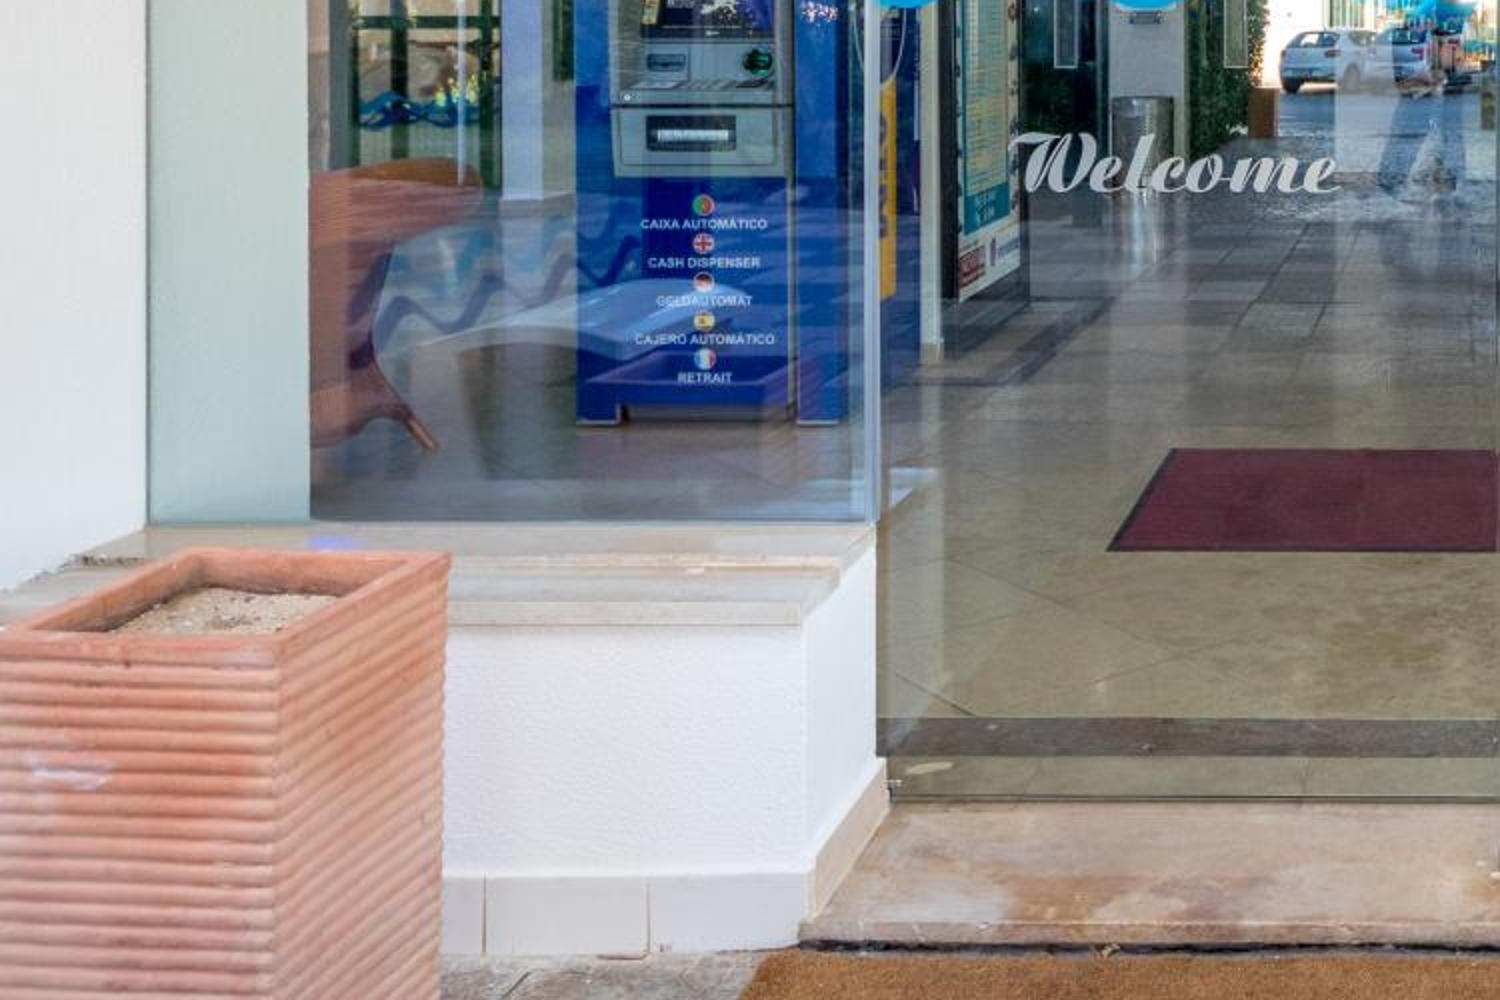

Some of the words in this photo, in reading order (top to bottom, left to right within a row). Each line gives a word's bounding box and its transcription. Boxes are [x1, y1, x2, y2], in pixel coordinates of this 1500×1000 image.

[1008, 131, 1342, 194] Welcome
[640, 218, 680, 230] CAIXA
[648, 257, 685, 269] CASH
[687, 257, 761, 269] DISPENSER
[656, 295, 753, 308] GELDAUTOMAT
[635, 333, 687, 345] CAJERO
[677, 371, 733, 384] RETRAIT
